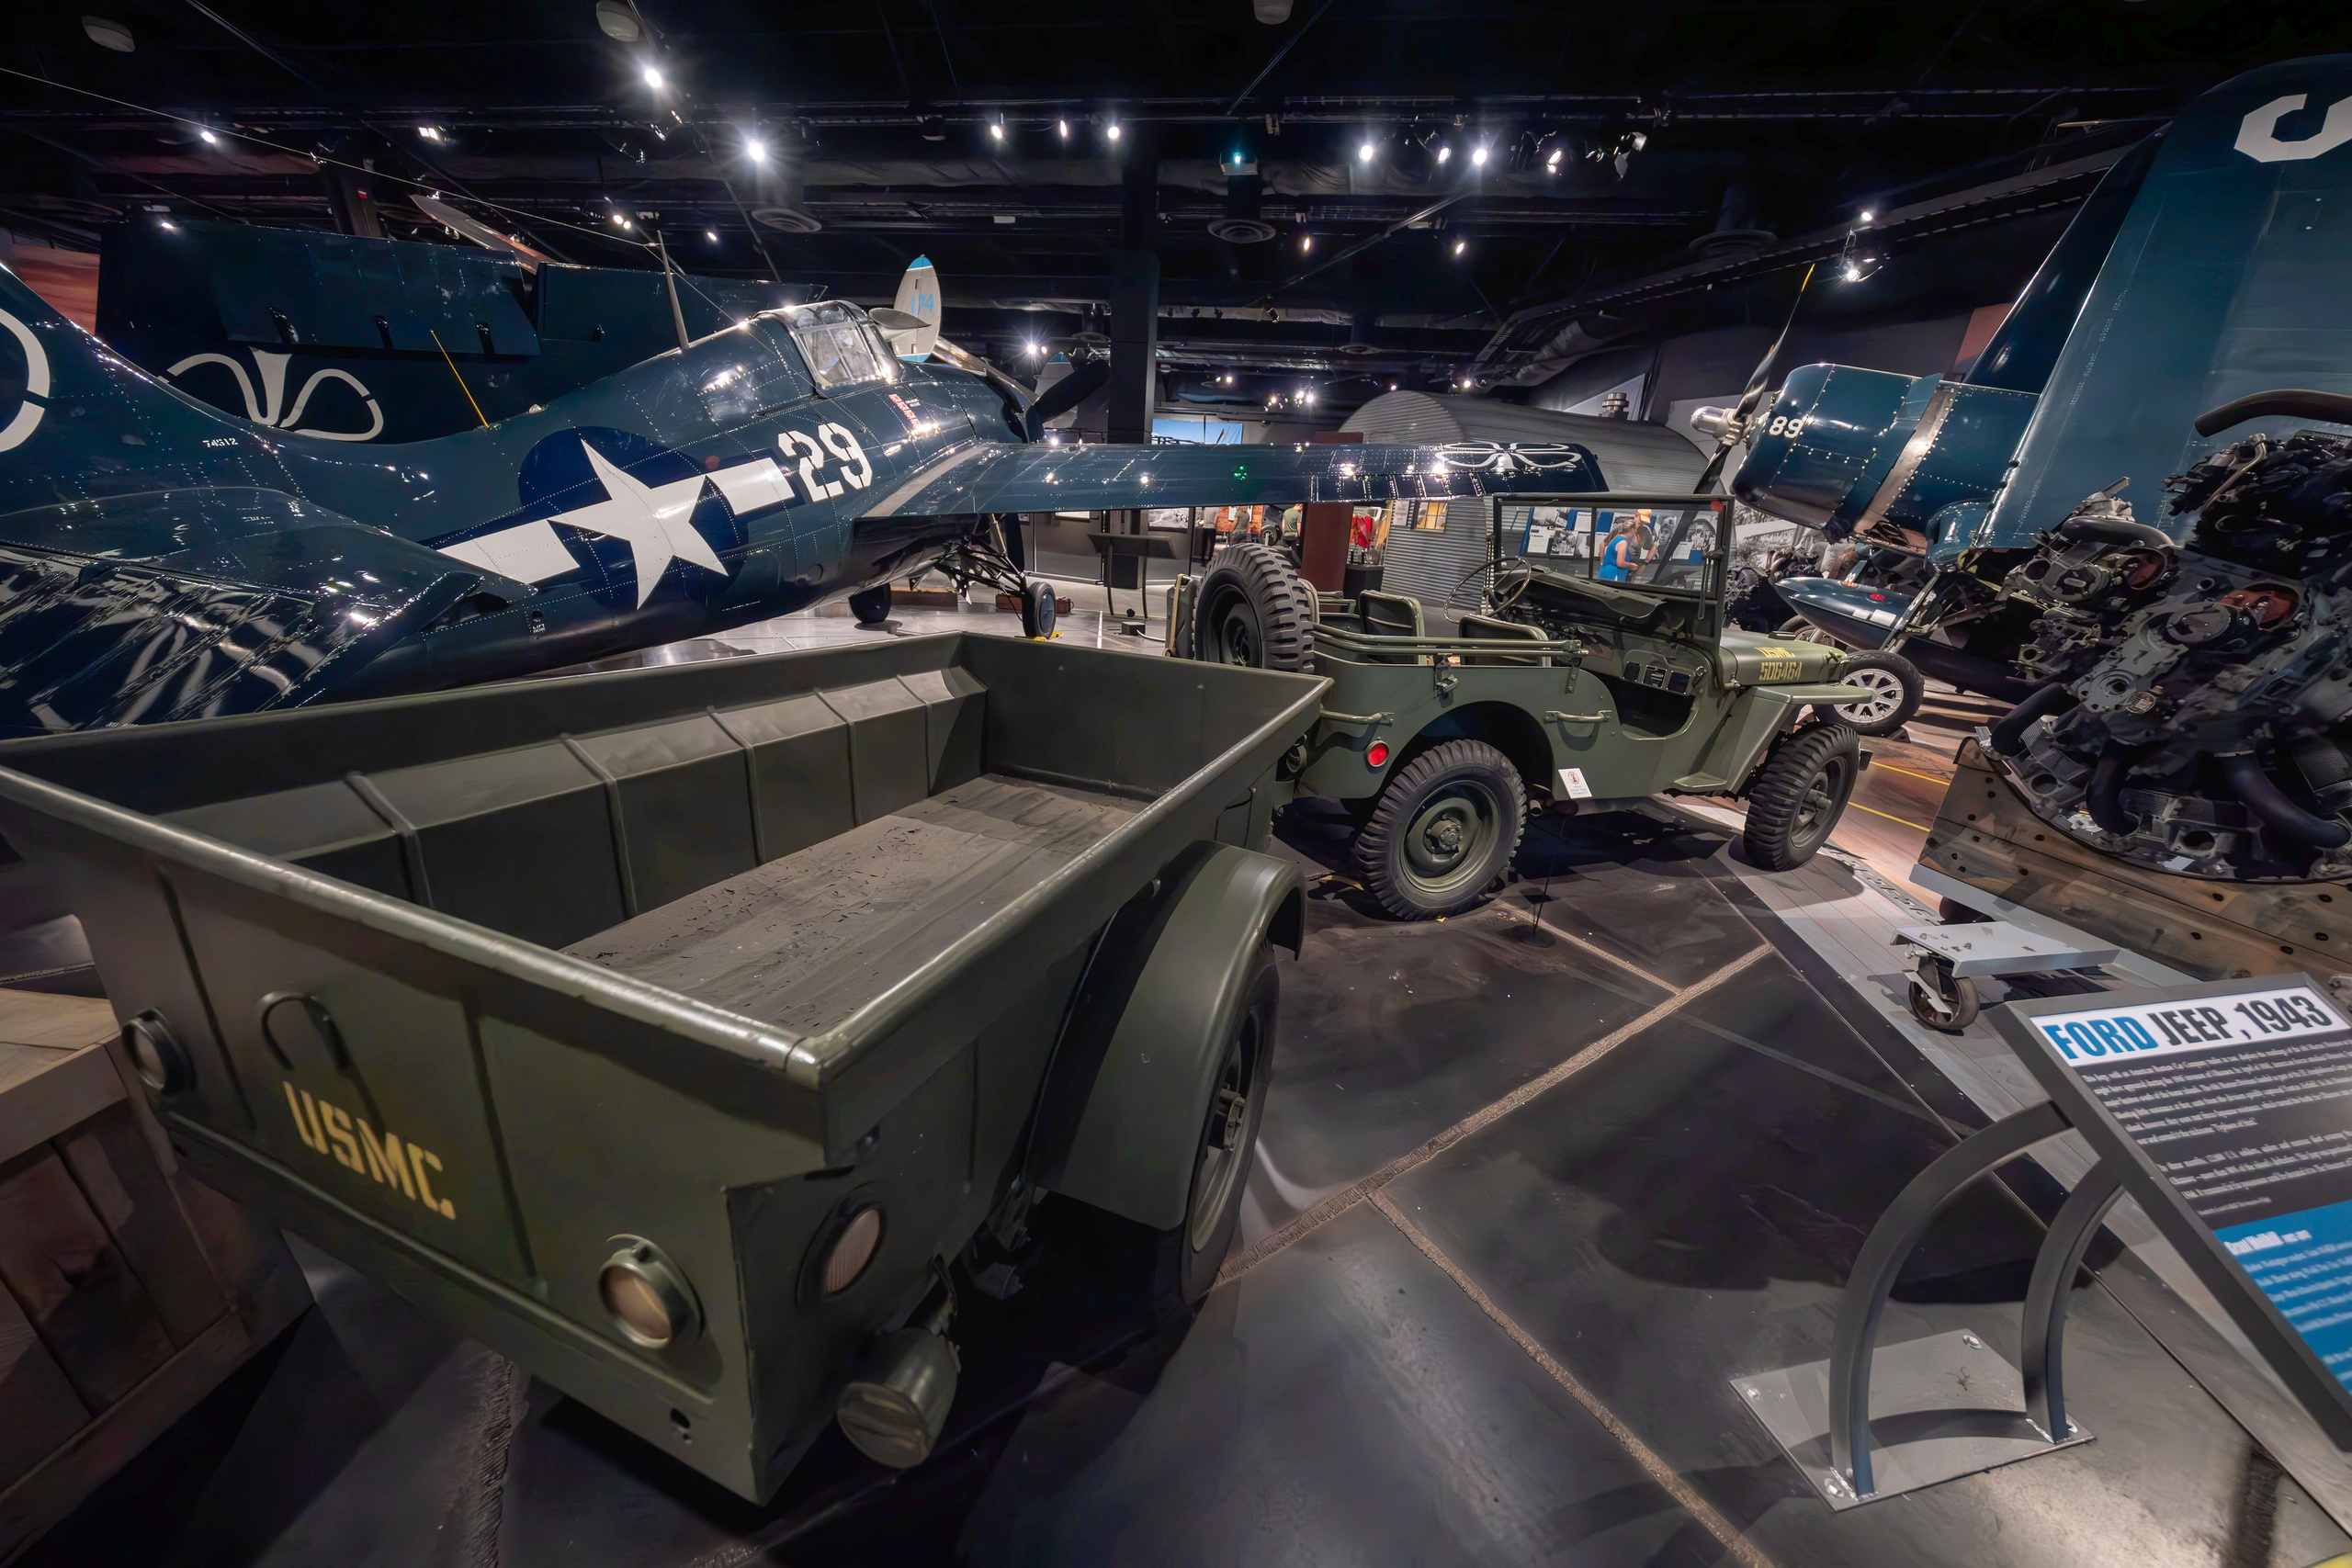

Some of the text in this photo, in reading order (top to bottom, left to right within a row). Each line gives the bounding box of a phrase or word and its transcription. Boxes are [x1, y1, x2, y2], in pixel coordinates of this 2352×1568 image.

[910, 293, 934, 317] 174
[1770, 415, 1804, 438] 89
[202, 437, 239, 448] 74512
[778, 423, 872, 502] 29
[1758, 661, 1803, 681] 506464
[2041, 1016, 2158, 1059] FORD
[2234, 995, 2333, 1033] 1943
[283, 1080, 456, 1220] USMC
